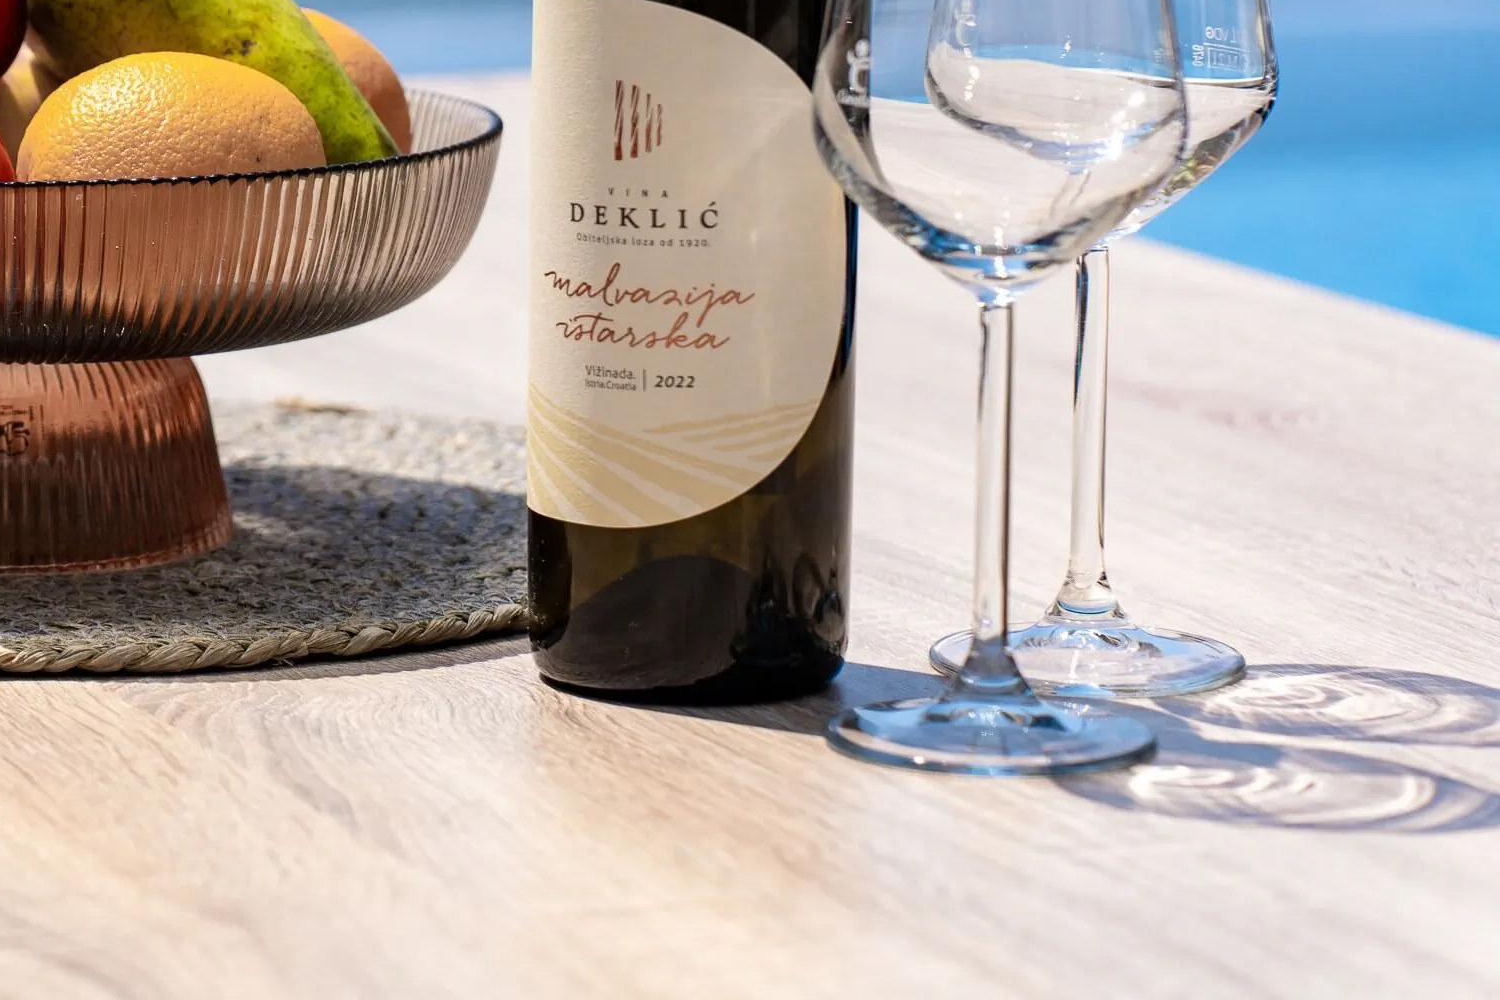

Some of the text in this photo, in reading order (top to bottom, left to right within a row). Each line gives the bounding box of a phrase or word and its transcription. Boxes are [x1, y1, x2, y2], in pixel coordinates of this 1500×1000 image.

[607, 188, 669, 199] VINA
[569, 201, 719, 230] DEKLIĆ
[659, 238, 673, 247] od
[544, 262, 756, 328] malvazija
[555, 311, 730, 350] istarska
[654, 374, 696, 389] 2022
